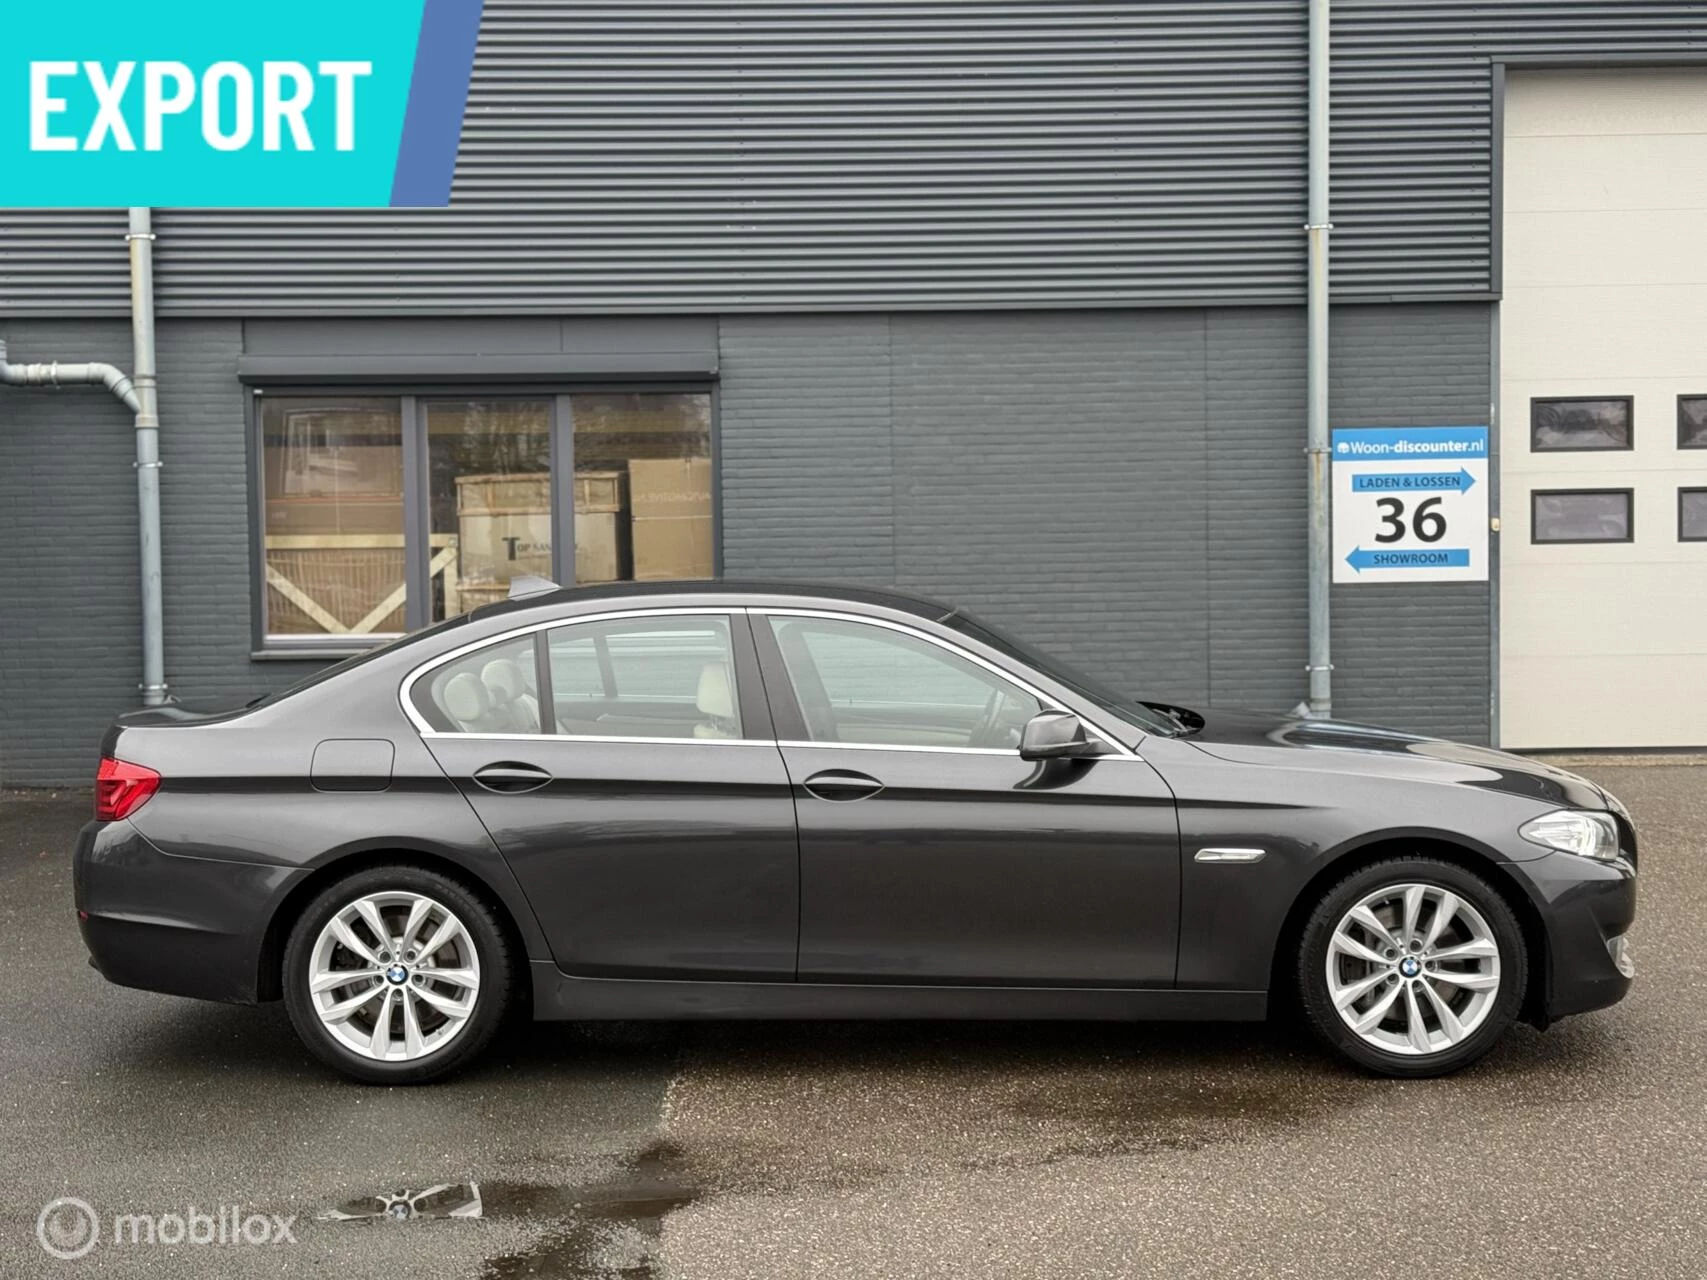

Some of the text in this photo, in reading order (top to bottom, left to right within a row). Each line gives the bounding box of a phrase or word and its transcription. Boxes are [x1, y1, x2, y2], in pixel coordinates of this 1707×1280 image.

[1351, 439, 1484, 454] Woon-discounter.nl
[1359, 476, 1461, 489] LADEN & LOSSEN
[1374, 496, 1447, 544] 36
[1373, 553, 1449, 565] SHOWROOM
